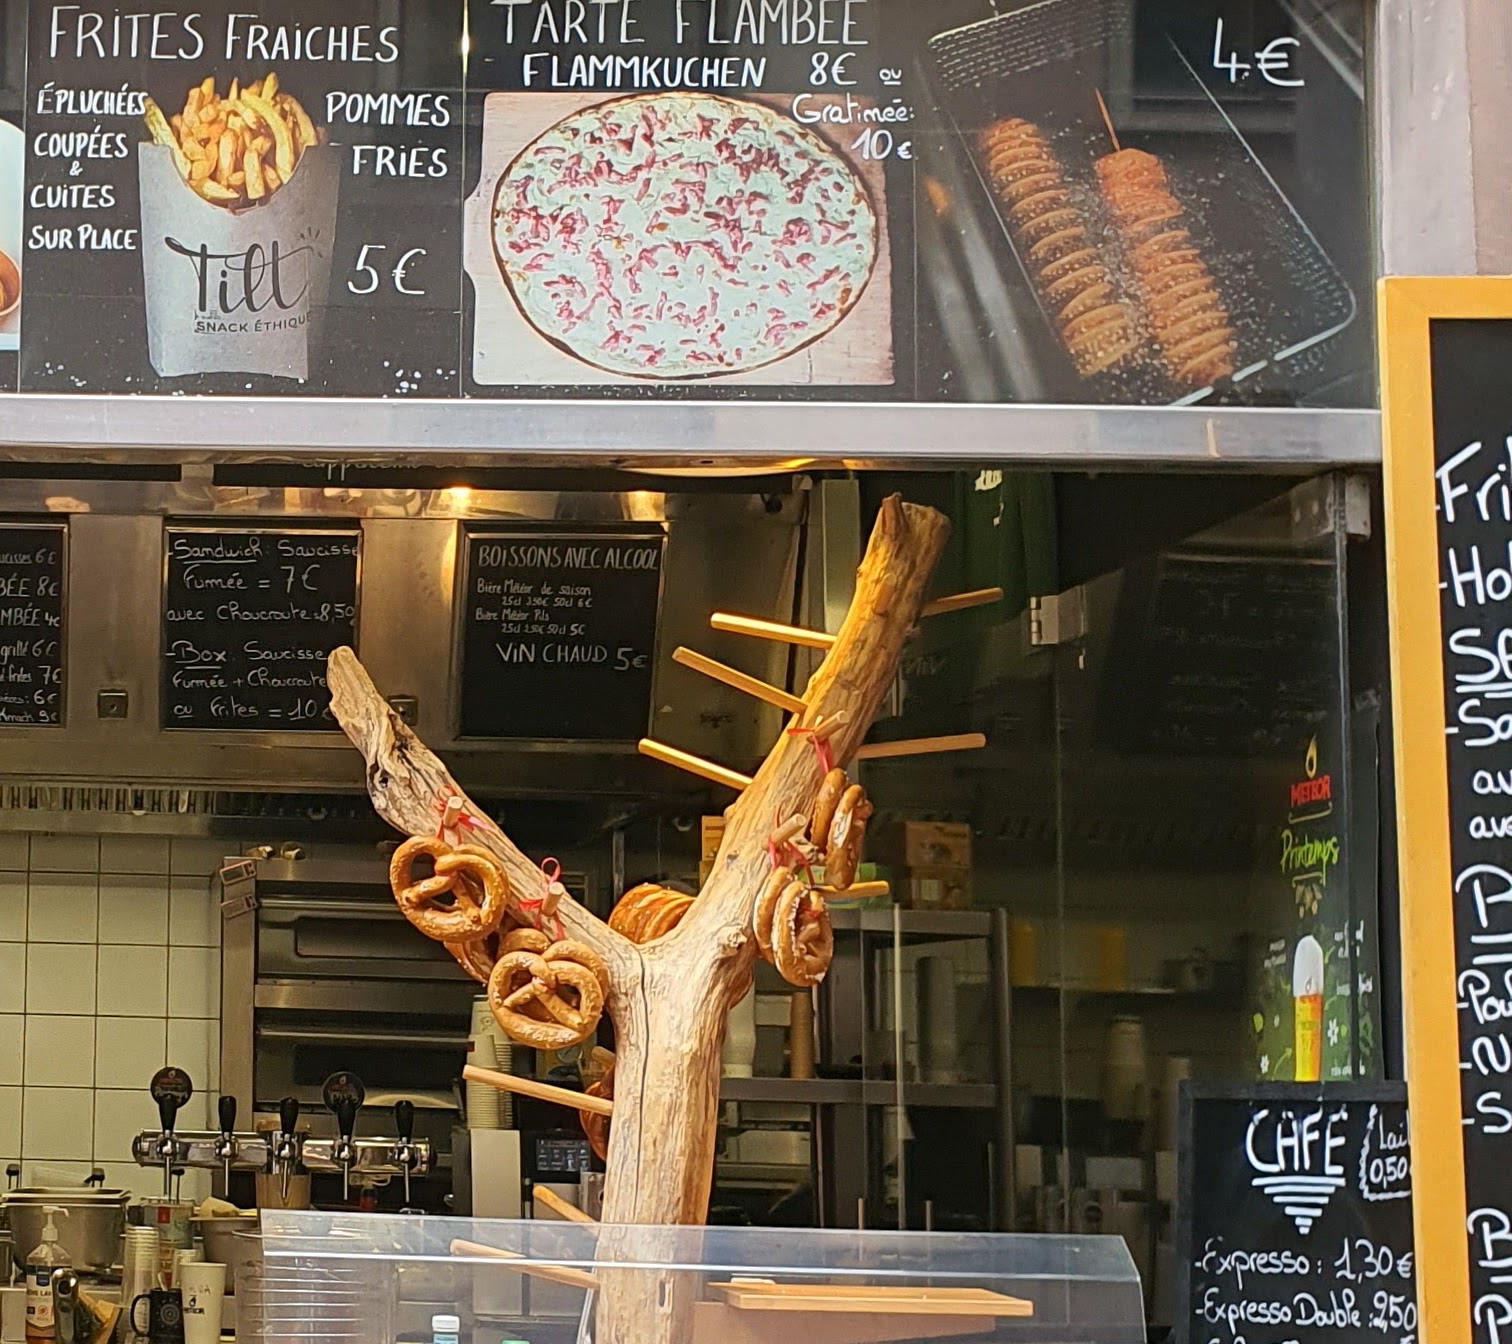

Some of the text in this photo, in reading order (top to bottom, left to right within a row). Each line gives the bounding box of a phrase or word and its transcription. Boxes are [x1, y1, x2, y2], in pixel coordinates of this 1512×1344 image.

[1212, 16, 1306, 90] 4€
[523, 54, 766, 89] FLAMMKUCHEN
[810, 52, 857, 85] 8€
[36, 82, 147, 116] ÉPLUCHÉES
[327, 91, 450, 127] POMMES
[34, 128, 128, 159] COUPÉES
[69, 160, 82, 176] &
[29, 224, 137, 252] SUR PLACE
[165, 236, 314, 313] Tilt
[196, 312, 310, 332] SNACK ÉTHIQUE
[278, 540, 358, 557] Saucisse
[564, 547, 658, 570] AVEC ALCOOL
[37, 576, 58, 597] 8€
[184, 564, 248, 590] Fumée
[541, 582, 552, 595] de
[559, 585, 591, 596] saison
[167, 610, 205, 620] avec
[244, 641, 328, 660] Saucisse
[543, 644, 648, 671] CHAUD 5€
[173, 670, 227, 688] Fumée
[211, 696, 258, 718] Frites
[1280, 829, 1339, 887] Printemps
[1204, 1287, 1291, 1335] Expresso
